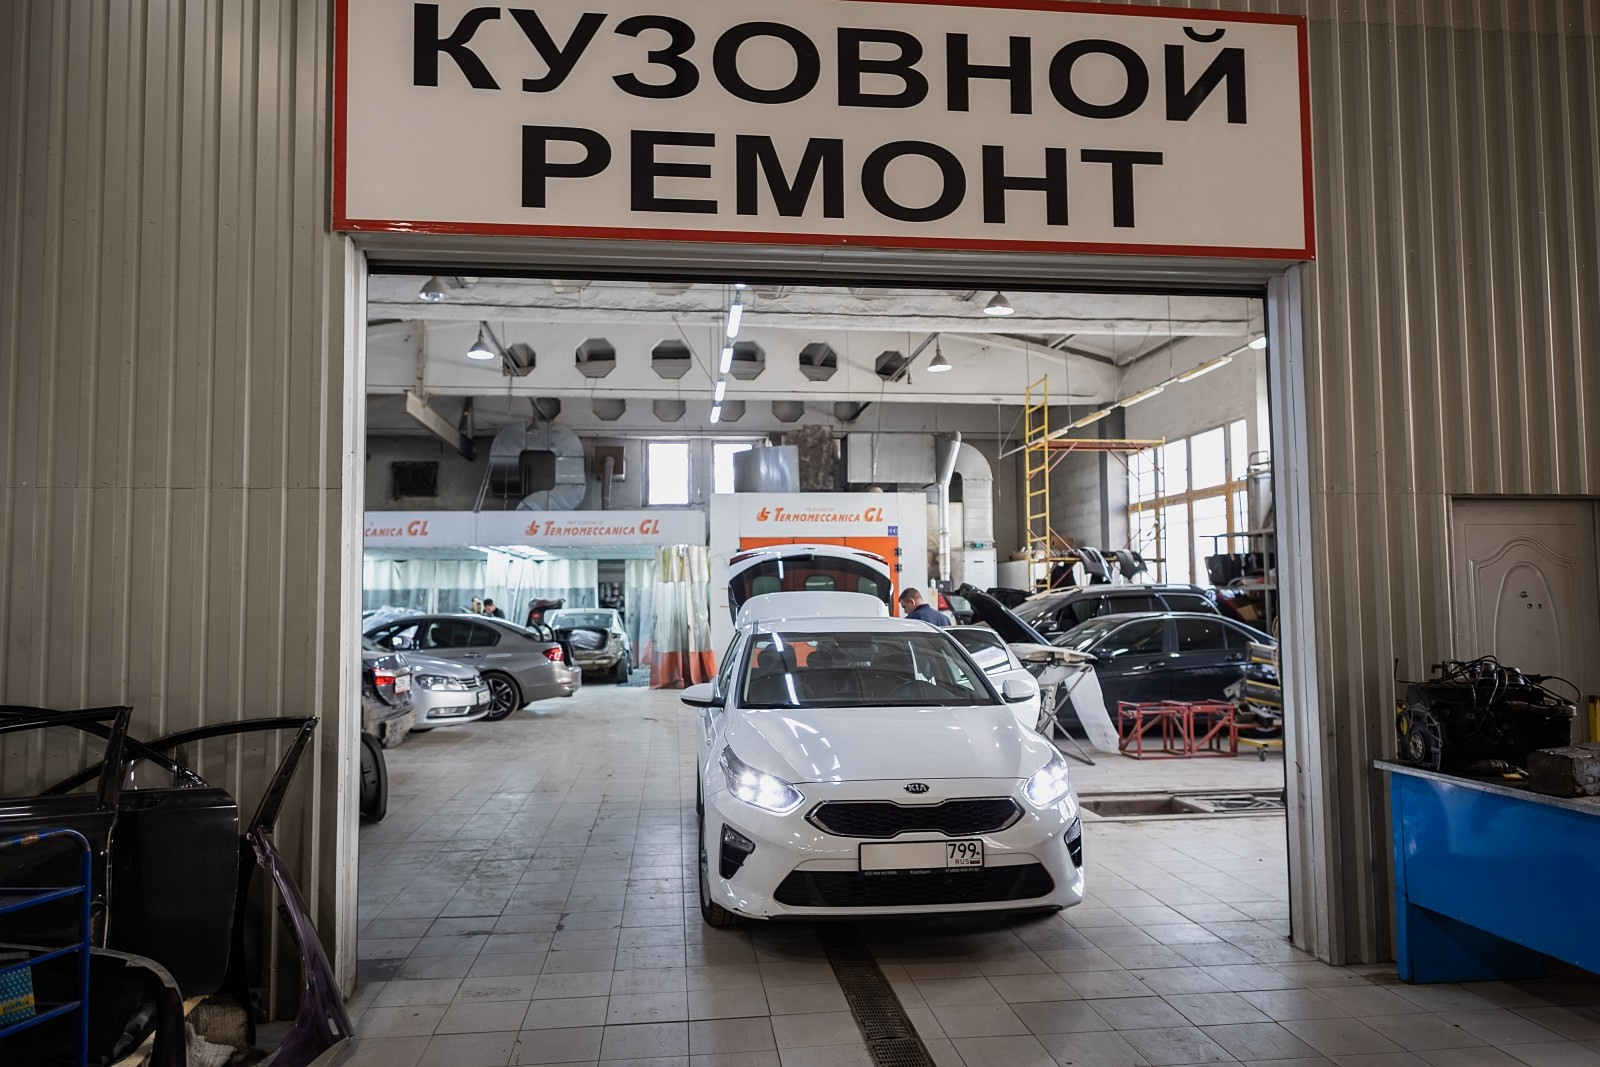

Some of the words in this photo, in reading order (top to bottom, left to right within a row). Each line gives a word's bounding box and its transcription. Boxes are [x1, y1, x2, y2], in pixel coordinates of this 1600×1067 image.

[413, 3, 1247, 125] КУЗОВНОЙ
[521, 124, 1164, 228] РЕМОНТ
[864, 507, 883, 522] GL
[407, 519, 429, 537] GL
[639, 519, 660, 535] GL
[906, 784, 927, 792] KIA
[948, 842, 976, 859] 799
